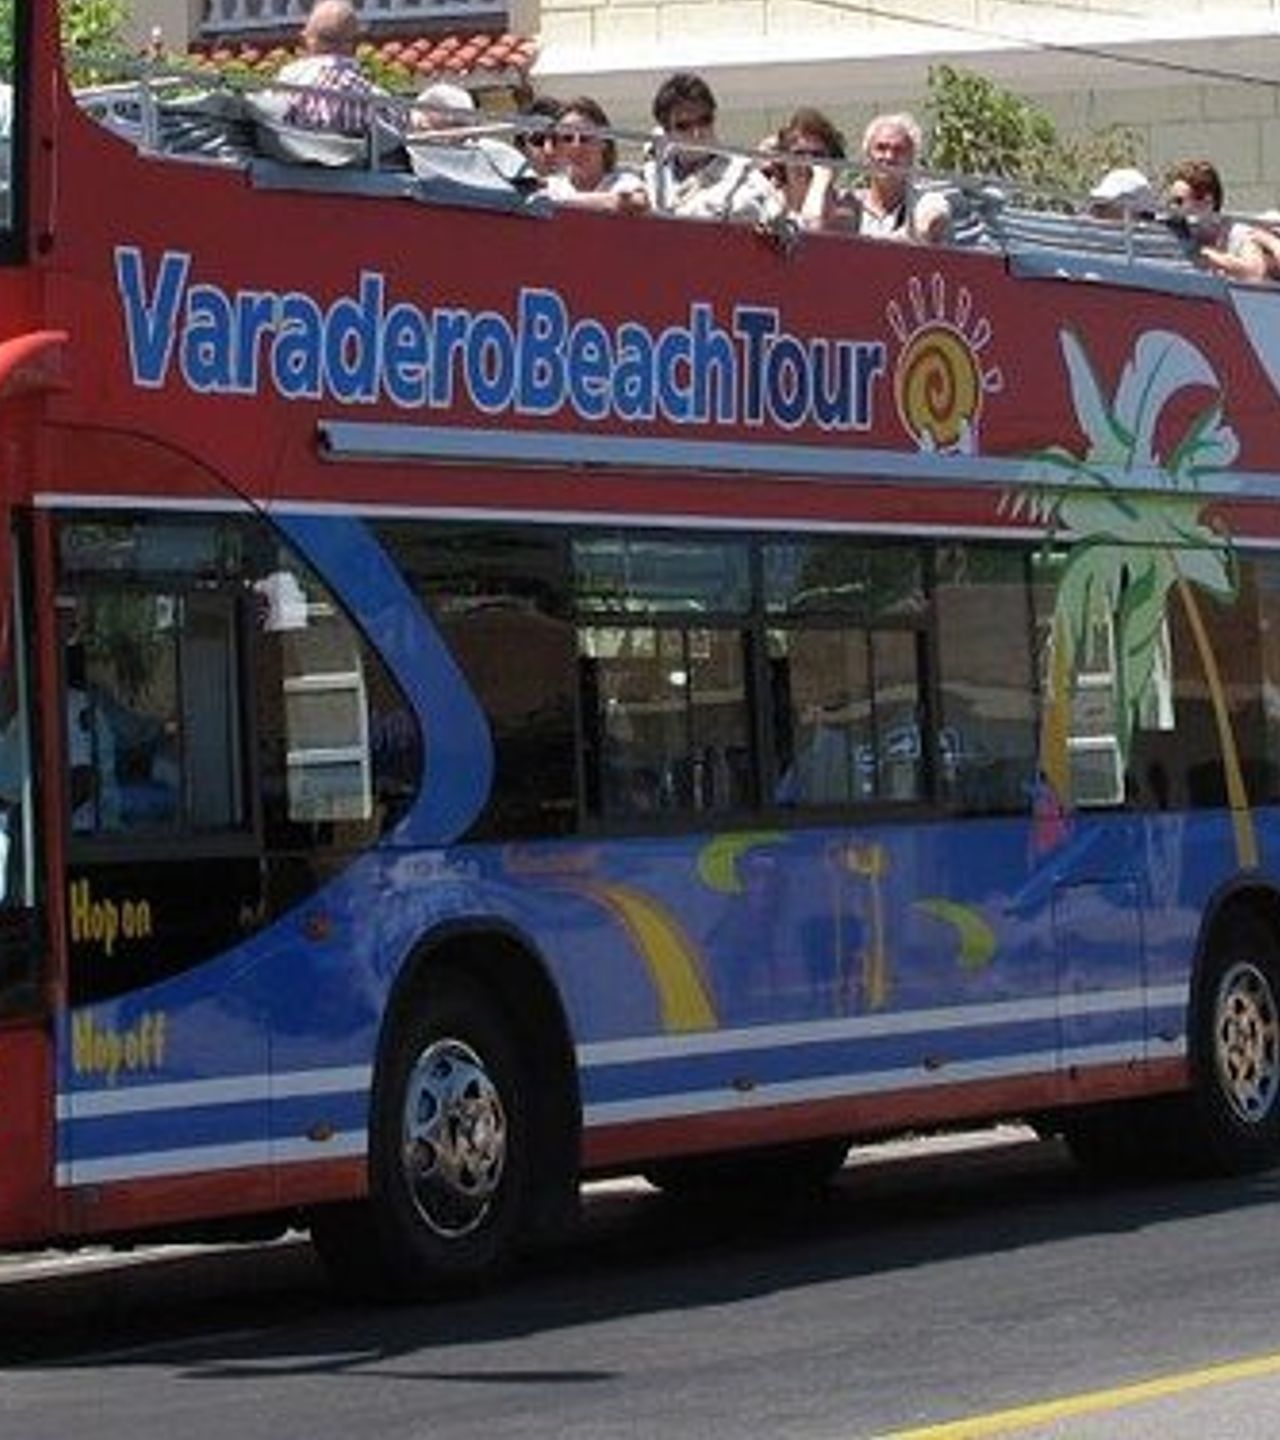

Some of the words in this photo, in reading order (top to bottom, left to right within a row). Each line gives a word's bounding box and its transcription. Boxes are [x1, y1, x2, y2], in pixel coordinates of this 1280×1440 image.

[116, 247, 885, 430] VaraderoBeachTour
[70, 877, 118, 956] Hop
[121, 898, 152, 938] on
[72, 1009, 120, 1086] Hop
[124, 1010, 166, 1069] off
